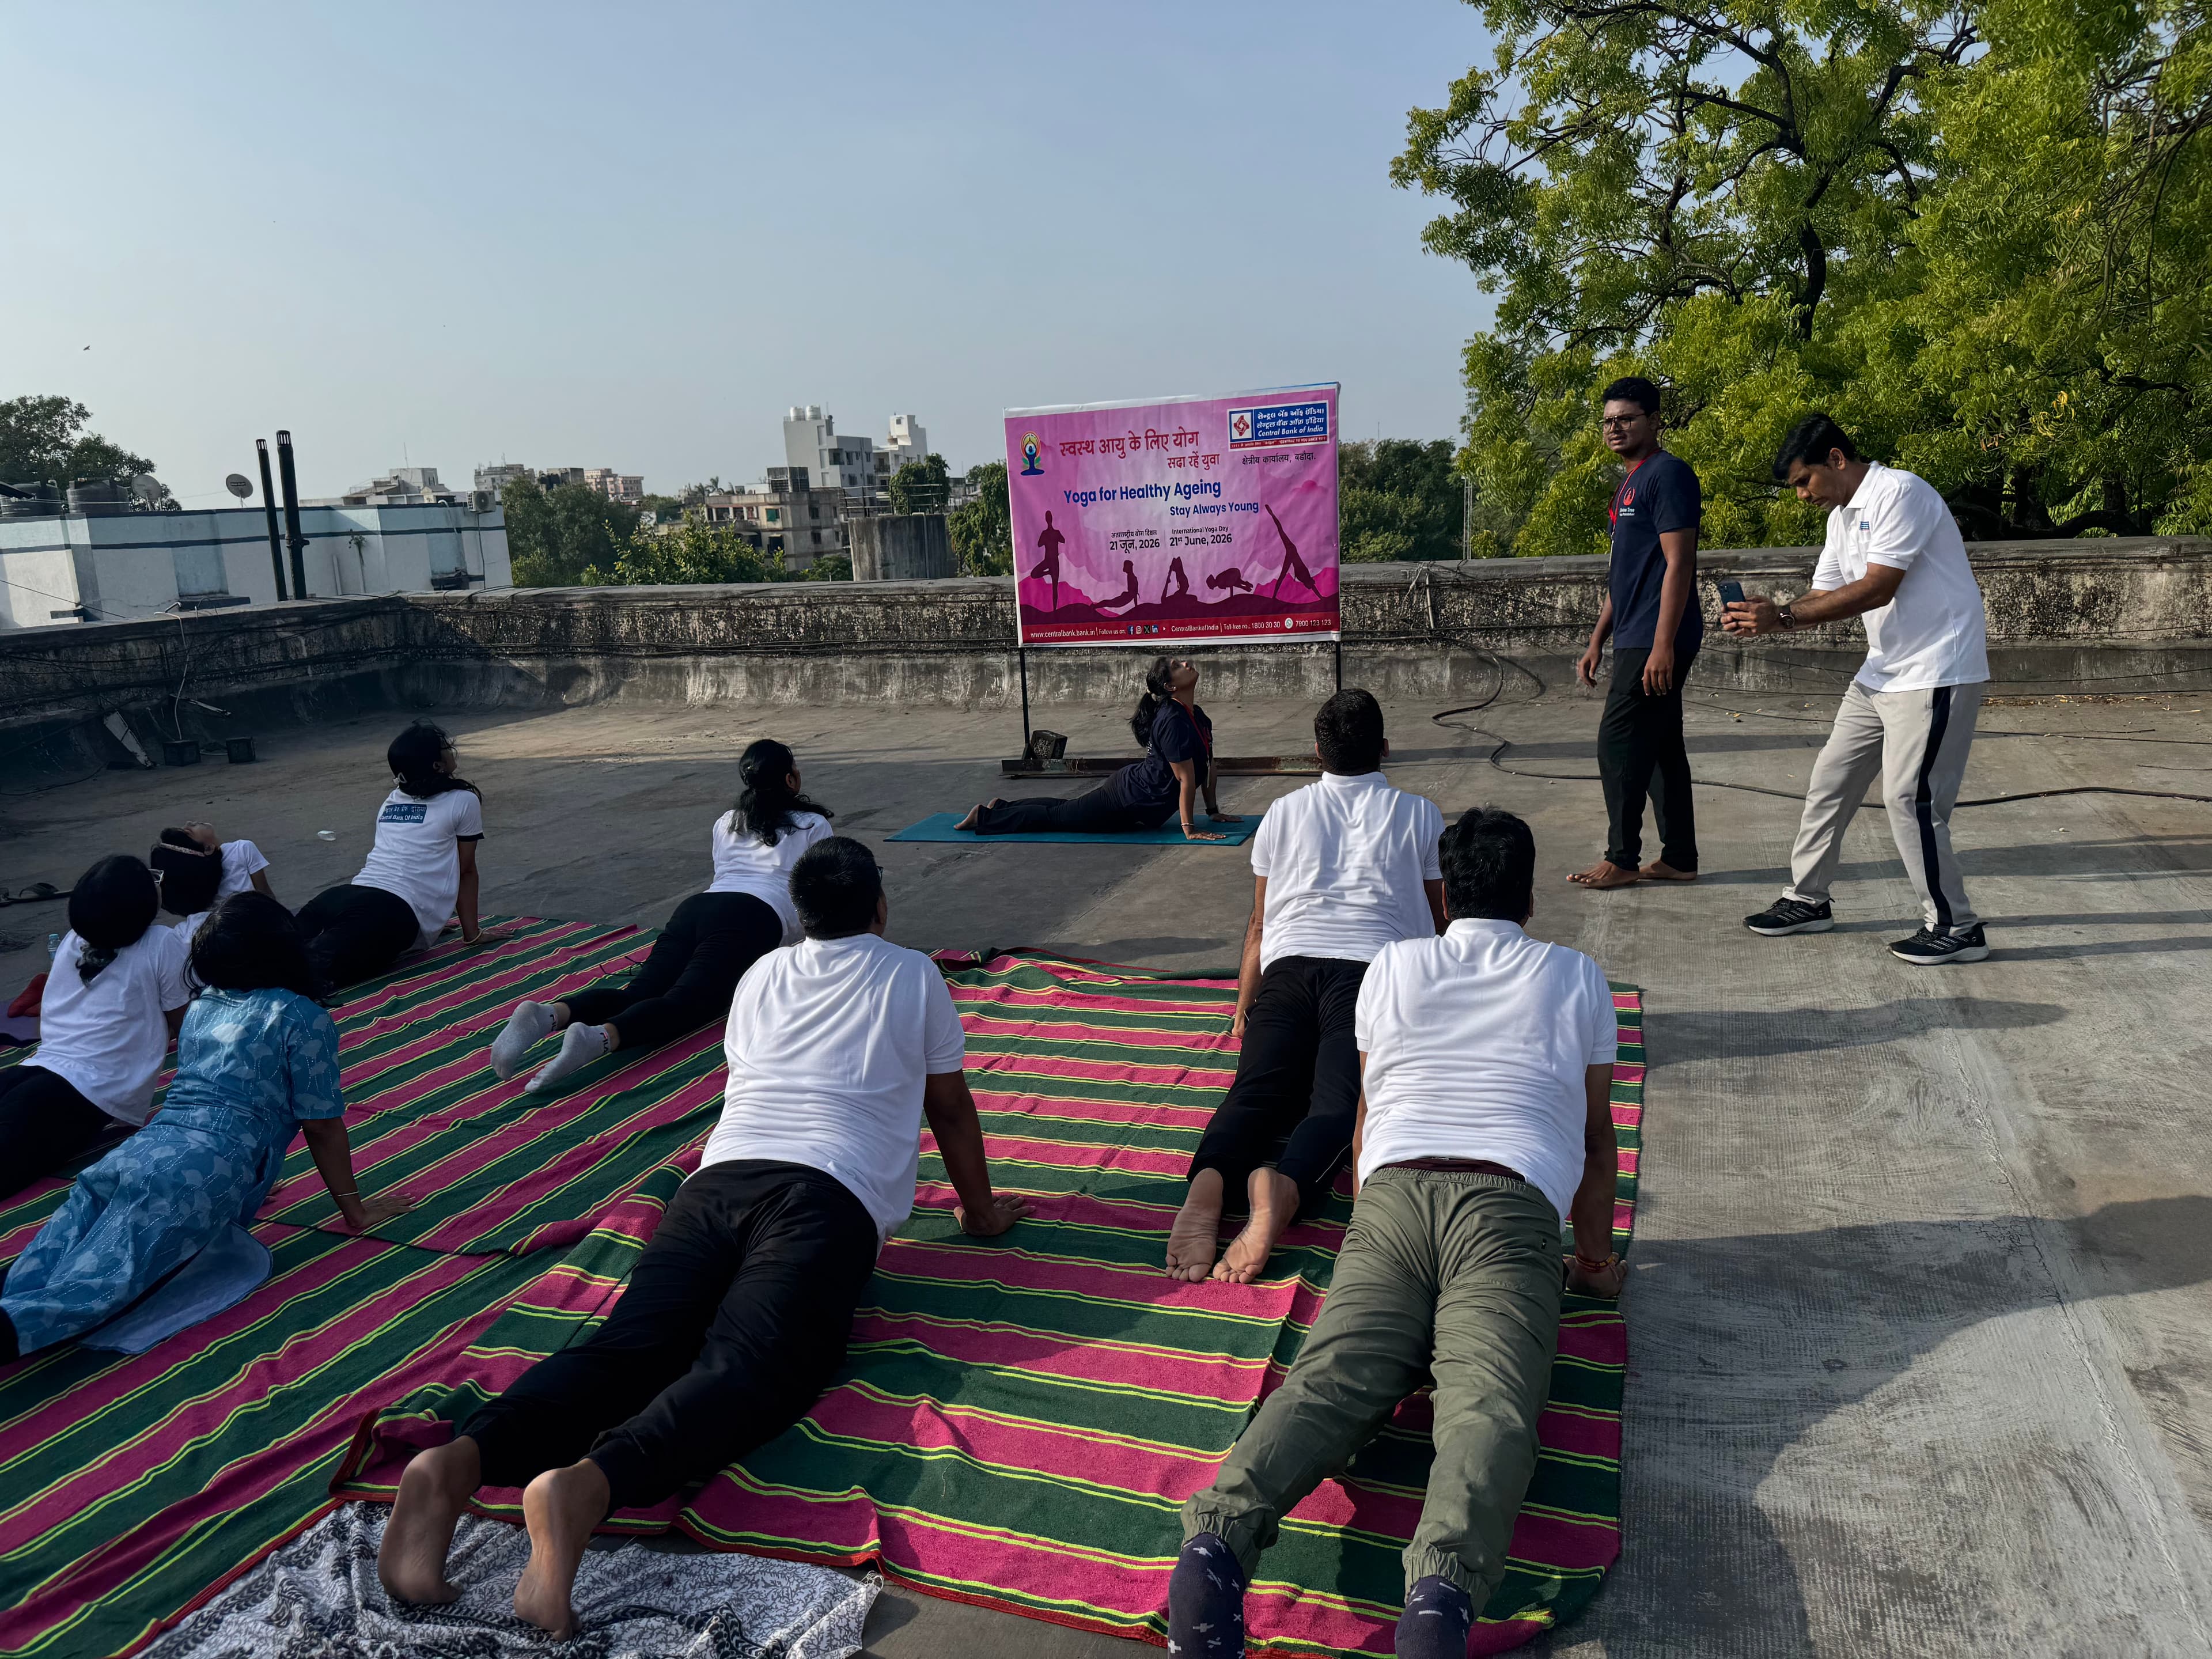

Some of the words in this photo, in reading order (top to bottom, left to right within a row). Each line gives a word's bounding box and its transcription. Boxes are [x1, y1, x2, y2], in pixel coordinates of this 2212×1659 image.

[1258, 429, 1280, 437] Central
[1281, 427, 1297, 435] Bank
[1059, 440, 1095, 457] स्वस्थ
[1099, 437, 1125, 459] आयु
[1128, 430, 1141, 451] के
[1145, 429, 1169, 452] लिए
[1172, 426, 1199, 448] योग
[1167, 456, 1185, 469] सदा
[1188, 451, 1199, 468] रहें
[1202, 454, 1220, 471] युवा
[1242, 454, 1260, 465] क्षेत्रीय
[1263, 453, 1291, 463] कार्यालय,
[1064, 490, 1097, 507] Yoga
[1099, 487, 1117, 501] for
[1120, 483, 1171, 501] Healthy
[1174, 479, 1221, 499] Ageing
[1170, 506, 1190, 518] Stay
[1193, 504, 1226, 516] Always
[1228, 501, 1259, 513] Young
[1172, 527, 1204, 535] International
[1169, 537, 1183, 546] 21st
[1184, 536, 1209, 546] June,
[1210, 533, 1232, 544] 2026
[1109, 541, 1118, 550] 21
[1119, 539, 1137, 554] जून,
[1139, 539, 1160, 548] 2026
[1031, 629, 1095, 638] www.centralbank.bank.in
[1171, 624, 1219, 632] CentralBankofIndia
